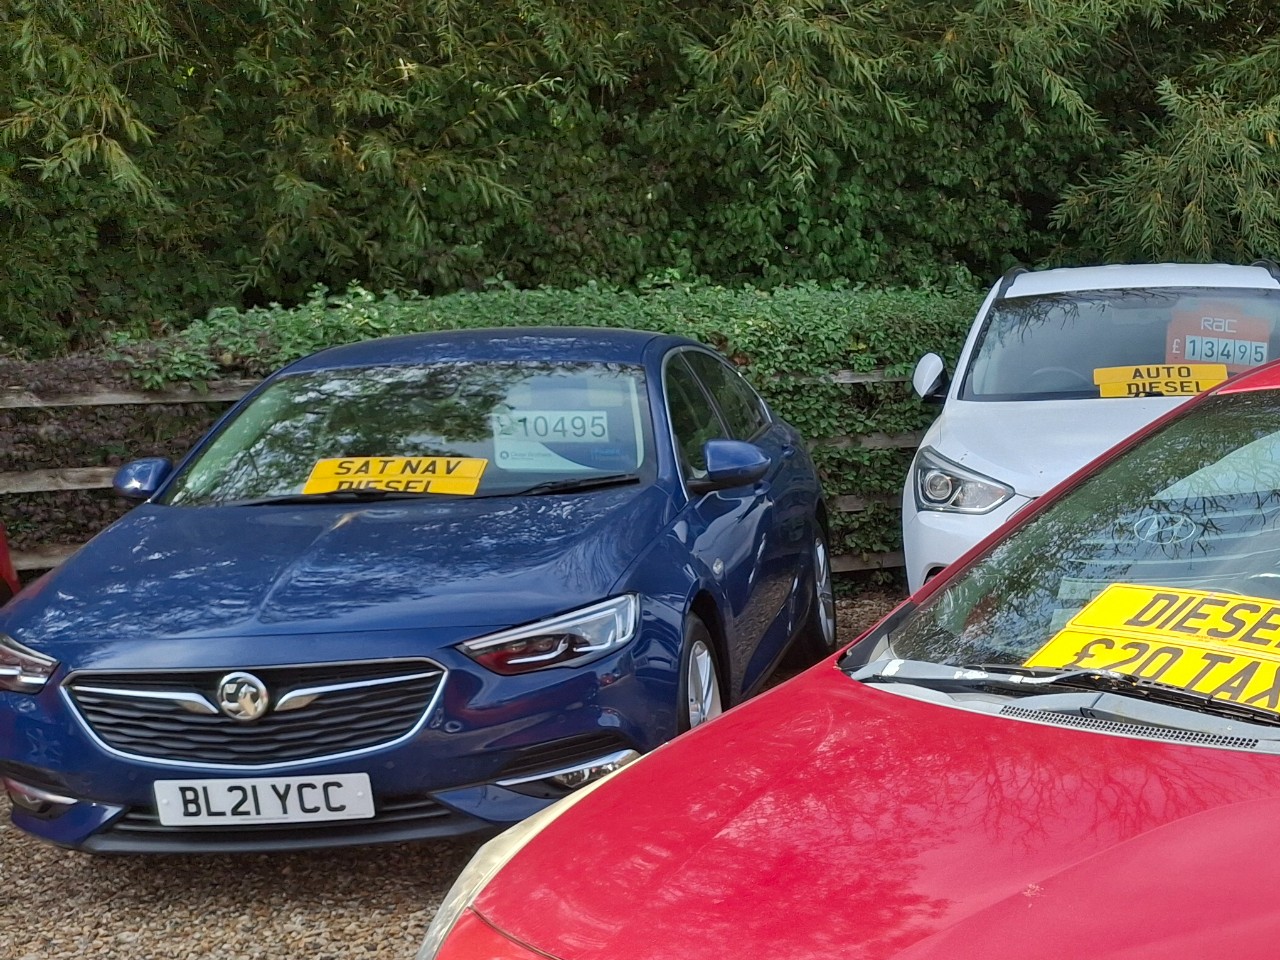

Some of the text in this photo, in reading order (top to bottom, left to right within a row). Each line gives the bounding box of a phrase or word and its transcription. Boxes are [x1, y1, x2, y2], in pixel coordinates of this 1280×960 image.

[1132, 366, 1192, 380] AUTO
[1126, 380, 1206, 396] DIESEL
[334, 460, 462, 476] SAT NAV
[1063, 637, 1184, 682] £20
[178, 781, 347, 817] BL21 YCC
